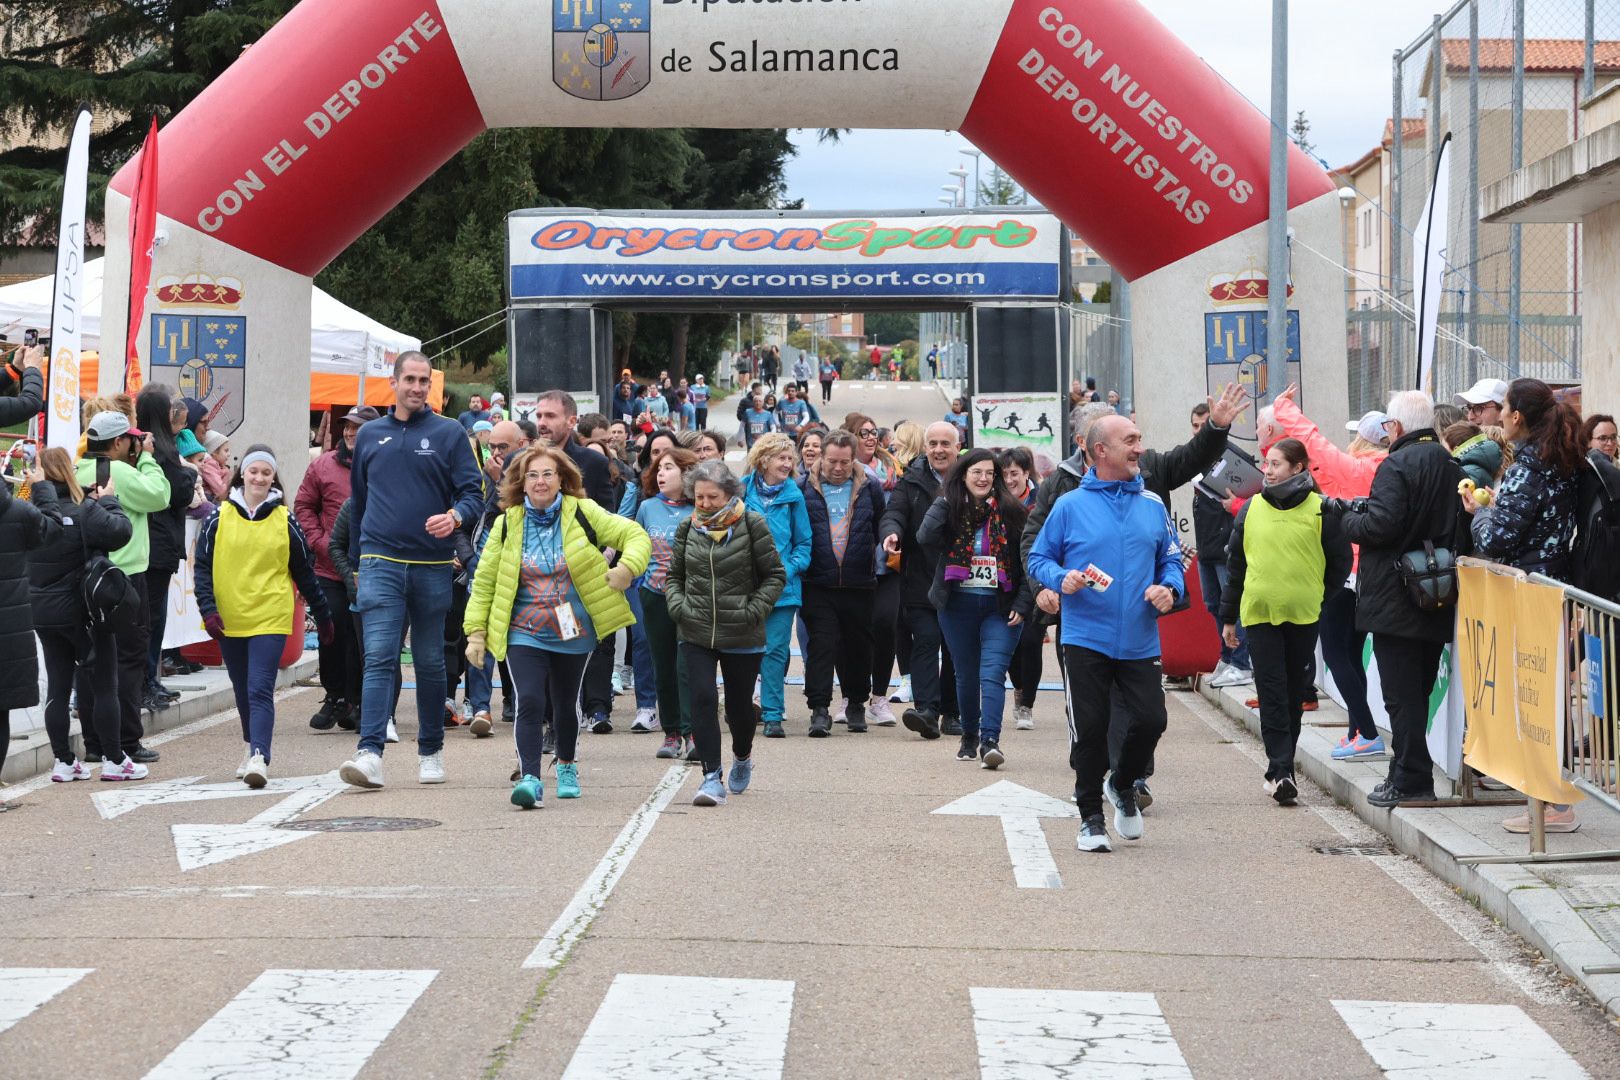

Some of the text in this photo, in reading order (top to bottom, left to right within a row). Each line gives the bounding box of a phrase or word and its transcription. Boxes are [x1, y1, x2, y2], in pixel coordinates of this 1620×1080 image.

[660, 39, 900, 73] de Salamanca
[1038, 6, 1254, 204] CON NUESTROS
[197, 11, 442, 232] CON EL DEPORTE
[1017, 48, 1211, 225] DEPORTISTAS
[62, 222, 79, 335] UPSA
[531, 219, 1038, 257] OrycronSport
[581, 270, 985, 289] www.orycronsport.com
